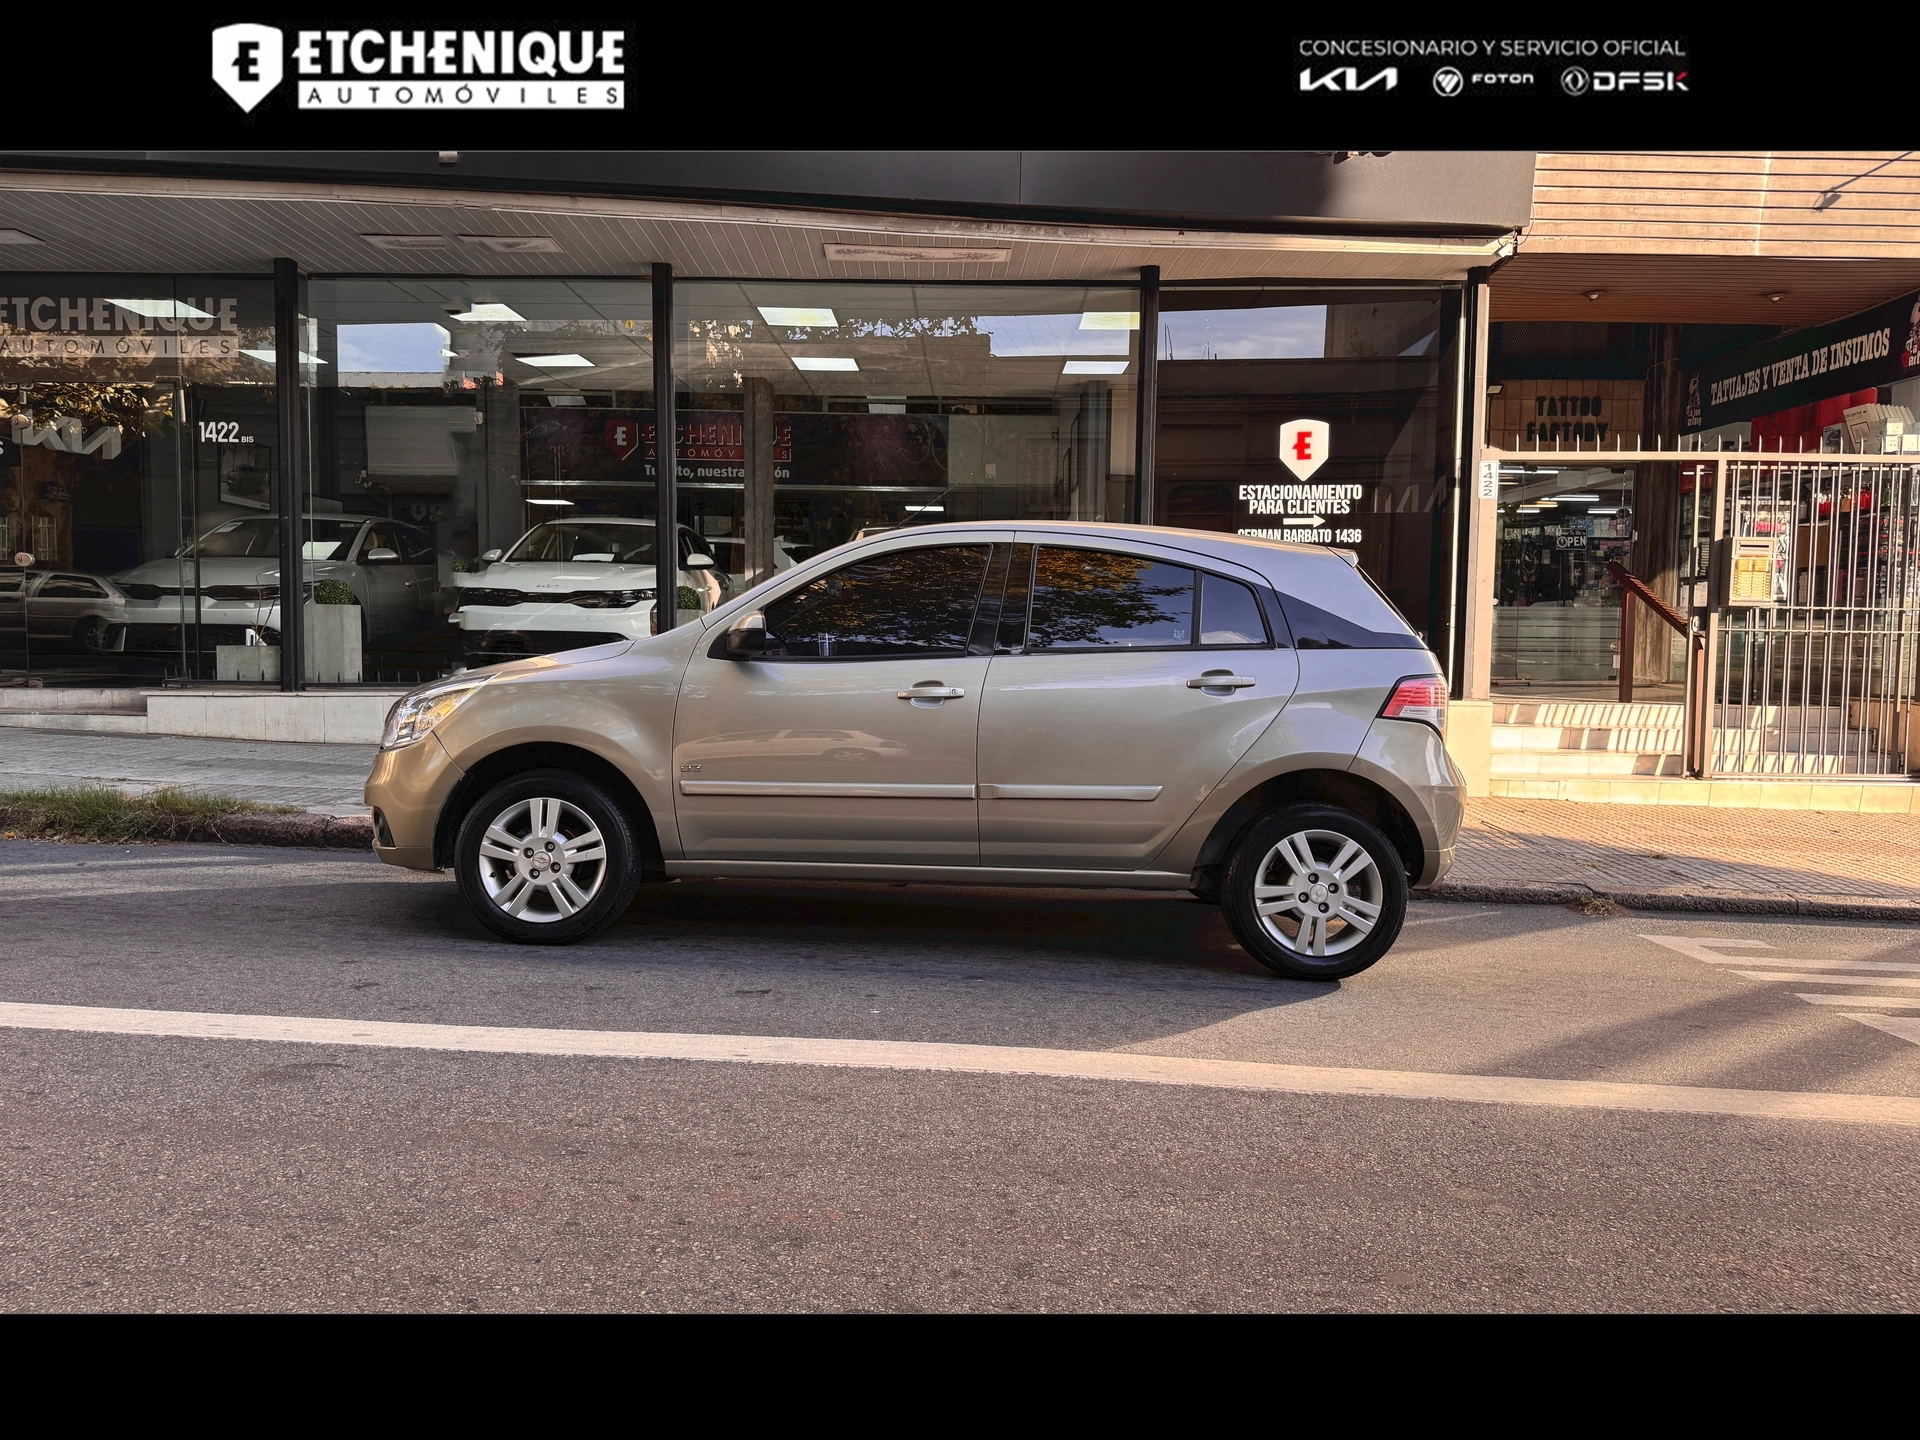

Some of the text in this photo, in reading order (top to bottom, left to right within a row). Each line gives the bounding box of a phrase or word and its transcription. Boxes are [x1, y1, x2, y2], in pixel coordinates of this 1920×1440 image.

[0, 337, 230, 354] AUTOMÓVILES
[1711, 367, 1760, 405] TATUAJES
[1762, 366, 1771, 390] Y
[1771, 353, 1809, 388] VENTA
[1811, 347, 1828, 376] DE
[1829, 327, 1891, 371] INSUMOS
[1536, 396, 1602, 416] TATTOO
[198, 421, 254, 443] 1422 BIS
[1526, 422, 1608, 442] FACTORY
[697, 466, 744, 478] nuestra
[1483, 463, 1493, 496] 1422
[1239, 484, 1362, 500] ESTACIONAMIENTO
[1249, 500, 1351, 514] PARA CLIENTES
[1283, 529, 1332, 543] BARBATO
[1335, 529, 1362, 543] 1436
[1556, 536, 1586, 548] OPEN
